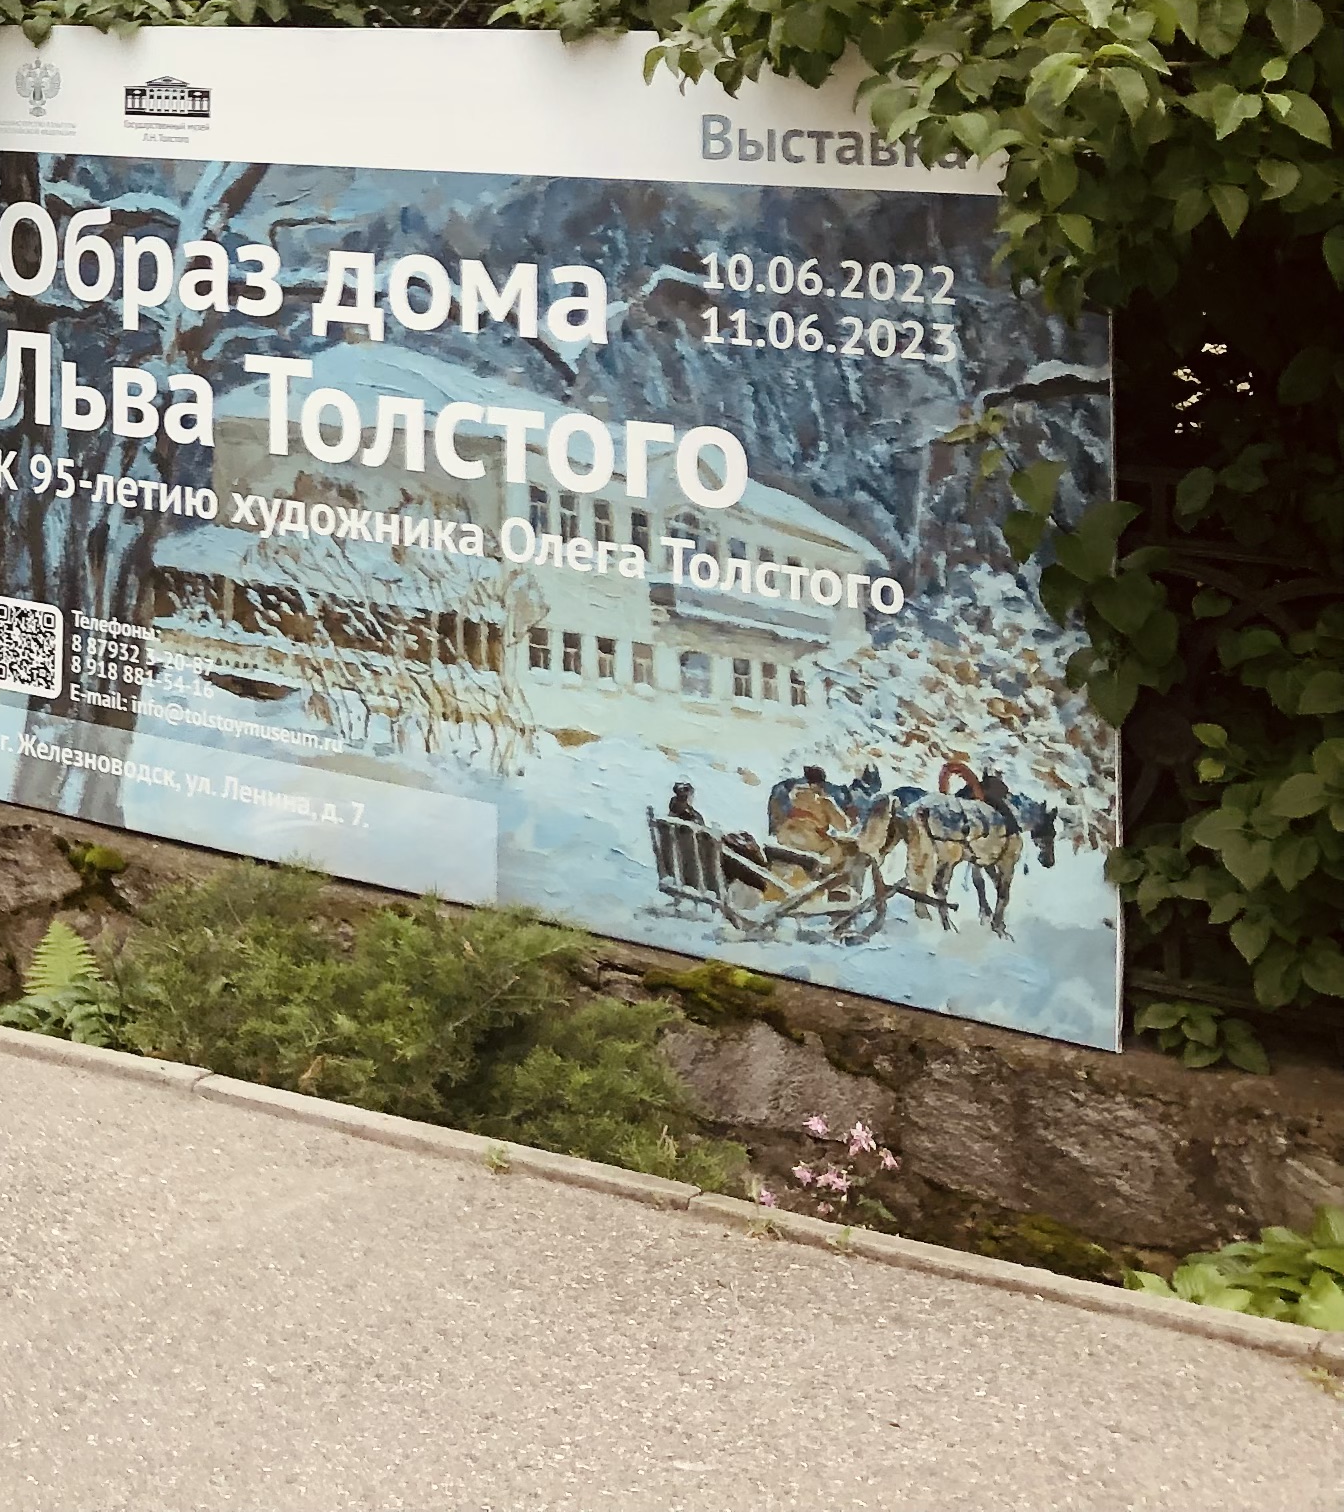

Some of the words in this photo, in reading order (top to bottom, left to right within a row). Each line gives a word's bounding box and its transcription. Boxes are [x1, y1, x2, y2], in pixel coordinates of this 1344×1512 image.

[312, 249, 609, 345] дома
[700, 252, 956, 306] 10.06.2022
[700, 306, 957, 363] 11.06.2023
[244, 354, 749, 509] Толстого
[30, 453, 218, 521] 95-летию
[230, 492, 484, 557] художника
[500, 516, 645, 580] Олега
[660, 536, 905, 615] Толстого
[71, 609, 161, 642] Телефоны:
[71, 634, 82, 653] 8
[87, 637, 140, 664] 87932
[71, 655, 82, 674] 8
[86, 658, 118, 681] 918
[70, 683, 128, 712] E-mail:
[132, 694, 343, 754] info@tolstoymuseum.ru
[0, 734, 13, 753] г.
[17, 733, 182, 792] Железноводск,
[186, 773, 216, 798] ул.
[221, 775, 317, 822] Ленина,
[321, 803, 344, 824] д.
[351, 801, 369, 828] 7.
